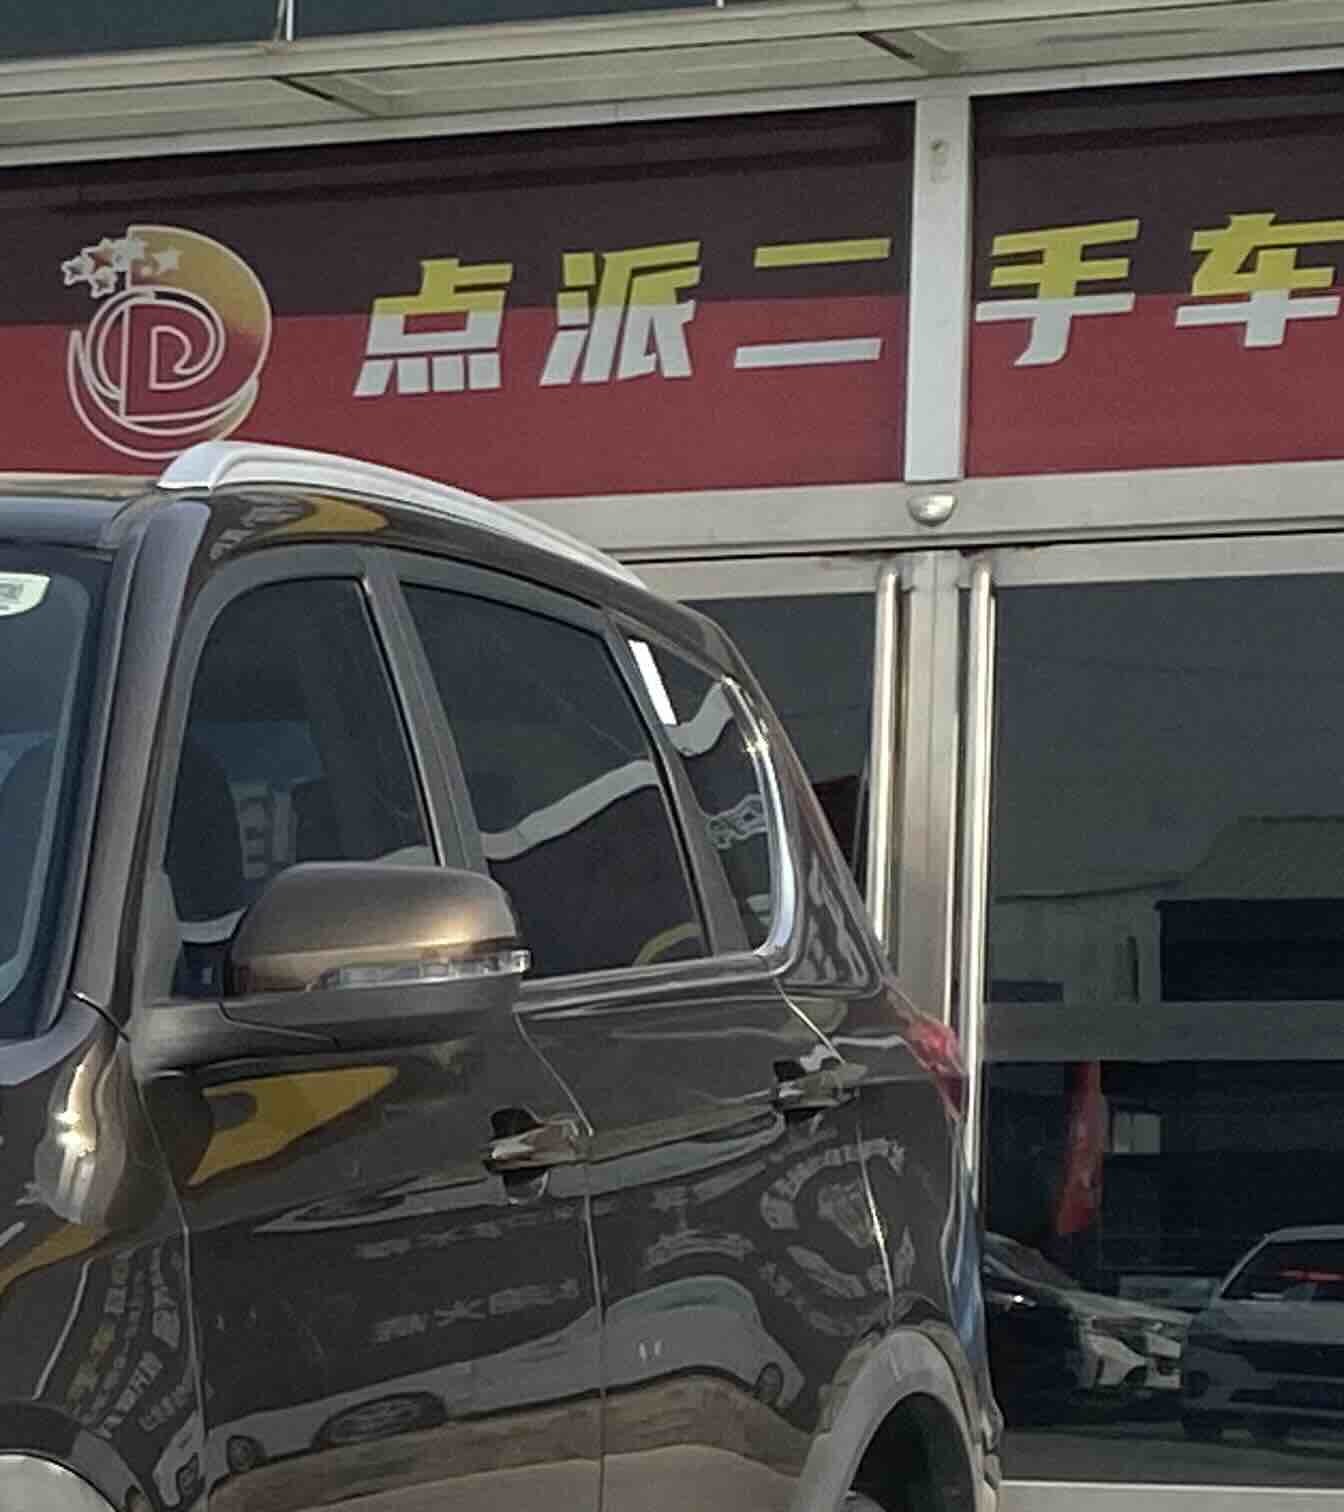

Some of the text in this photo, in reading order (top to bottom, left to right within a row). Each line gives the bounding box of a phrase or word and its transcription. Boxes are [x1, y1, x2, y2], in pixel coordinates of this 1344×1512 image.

[353, 212, 1344, 398] 点派二手车
